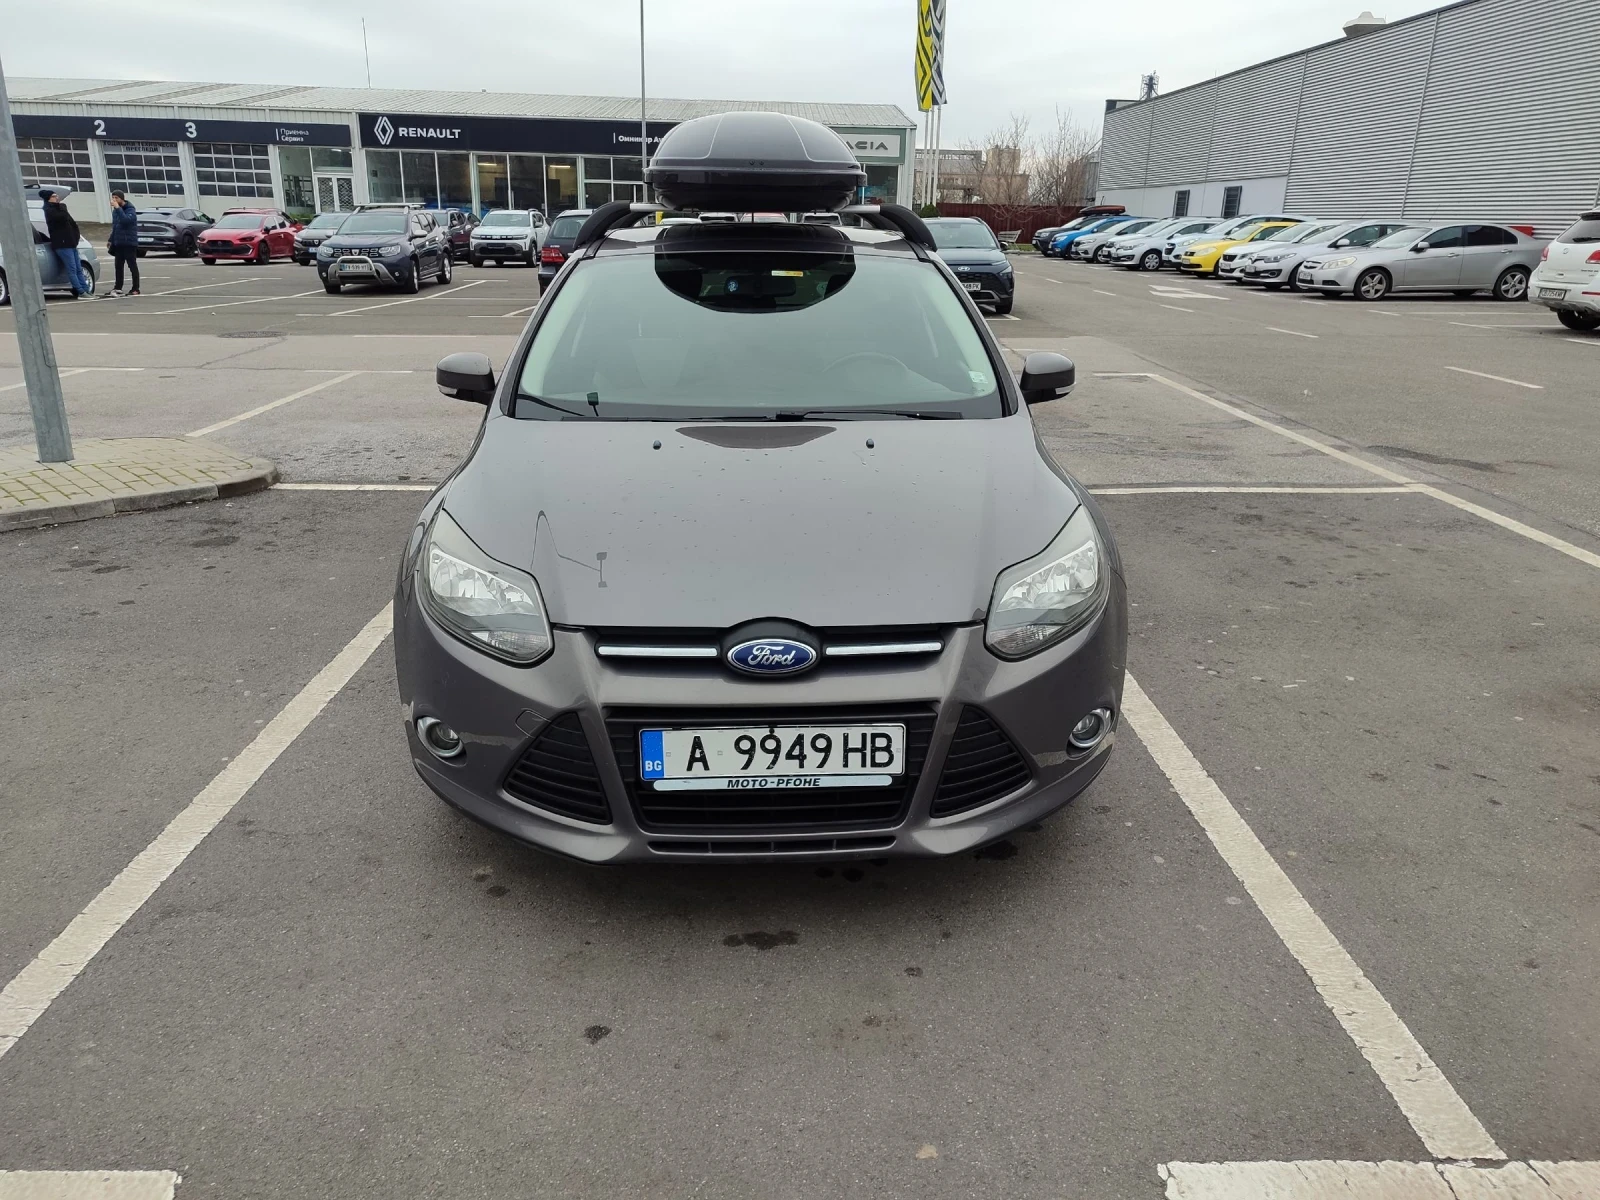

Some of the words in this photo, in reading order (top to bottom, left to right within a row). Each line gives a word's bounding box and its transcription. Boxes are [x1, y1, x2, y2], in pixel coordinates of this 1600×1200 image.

[94, 120, 107, 136] 2
[185, 122, 197, 138] 3
[398, 127, 461, 139] RENAULT
[618, 135, 653, 144] Омникр
[845, 141, 888, 150] ACIA
[747, 644, 796, 666] Ford
[686, 736, 710, 772] A
[734, 733, 833, 771] 9949
[842, 732, 895, 769] HB
[645, 760, 662, 772] BG
[727, 777, 821, 789] MOTO-PFOHE
